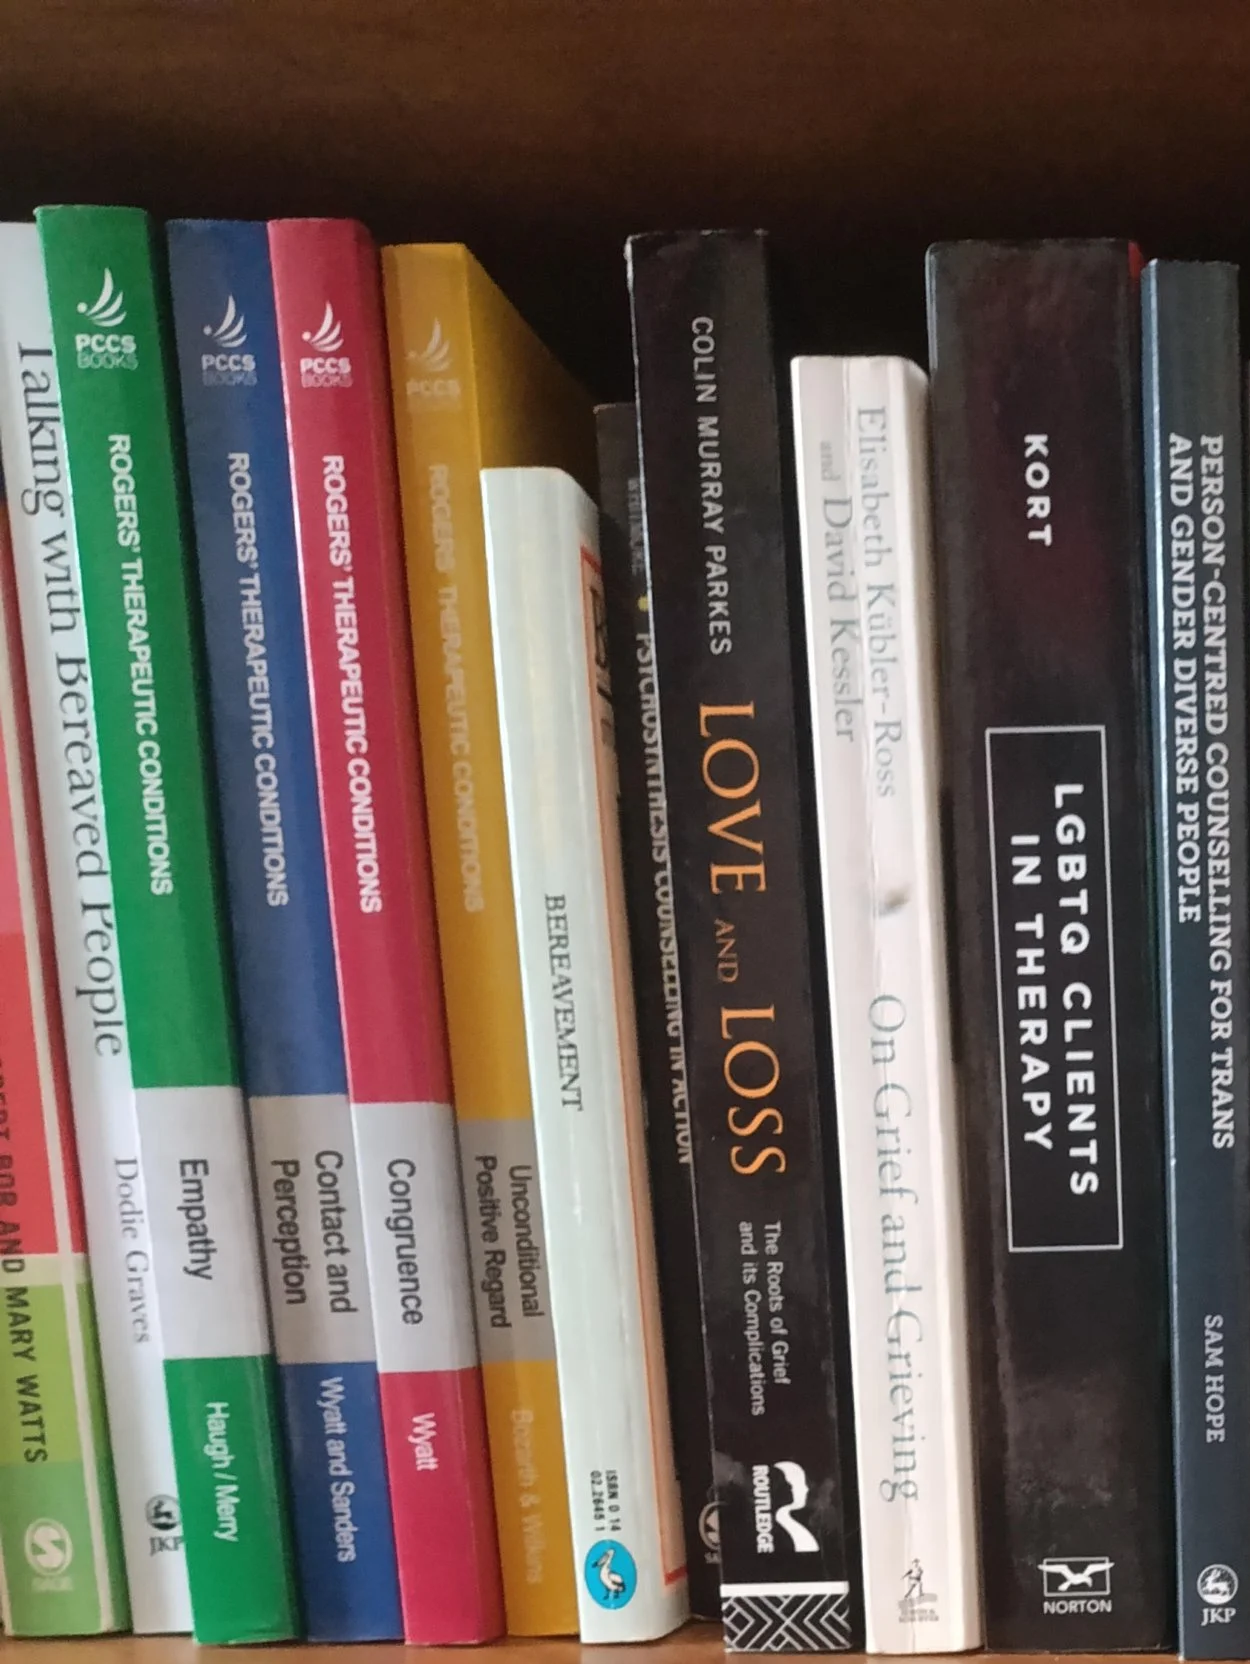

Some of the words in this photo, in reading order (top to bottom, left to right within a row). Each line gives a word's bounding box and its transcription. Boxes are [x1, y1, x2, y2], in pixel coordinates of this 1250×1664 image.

[75, 334, 136, 354] PCCS
[201, 355, 255, 371] PCCS
[300, 359, 351, 374] PCCS
[692, 317, 717, 403] COLIN
[697, 416, 724, 535] MURRAY
[1024, 433, 1052, 547] KORT
[1169, 433, 1194, 507] AND
[705, 545, 732, 656] PARKES
[1170, 514, 1198, 650] GENDER
[1200, 434, 1229, 736] PERSON-CENTRED
[1172, 656, 1200, 795] DIVERSE
[700, 701, 767, 894] LOVE
[1010, 834, 1042, 886] IN
[1054, 783, 1091, 955] LGBTQ
[1175, 801, 1202, 924] PEOPLE
[1206, 742, 1232, 973] COUNSELLING
[714, 919, 739, 984] AND
[544, 894, 583, 1111] BEREAVEMENT
[869, 993, 906, 1067] On
[1015, 912, 1053, 1151] THERAPY
[1209, 979, 1232, 1040] FOR
[721, 1005, 787, 1175] LOSS
[1063, 982, 1099, 1195] CLIENTS
[1211, 1047, 1235, 1150] TRANS
[872, 1082, 920, 1206] Grief
[176, 1158, 218, 1280] Empathy
[271, 1160, 311, 1305] Perception
[314, 1150, 351, 1259] Contact
[385, 1157, 424, 1327] Congruence
[508, 1165, 545, 1318] Unconditional
[739, 1222, 757, 1256] and
[763, 1220, 782, 1254] The
[327, 1266, 358, 1313] and
[741, 1262, 759, 1284] its
[766, 1261, 784, 1312] Roots
[879, 1213, 923, 1295] and
[742, 1289, 765, 1417] Complications
[769, 1316, 787, 1335] of
[771, 1338, 791, 1386] Grief
[1203, 1314, 1224, 1370] SAM
[411, 1411, 438, 1472] Wyatt
[881, 1310, 926, 1504] Grieving
[1205, 1374, 1226, 1444] HOPE
[751, 1465, 774, 1554] ROUTLEDGE
[1042, 1598, 1112, 1616] NORTON
[1200, 1607, 1237, 1627] JKP
